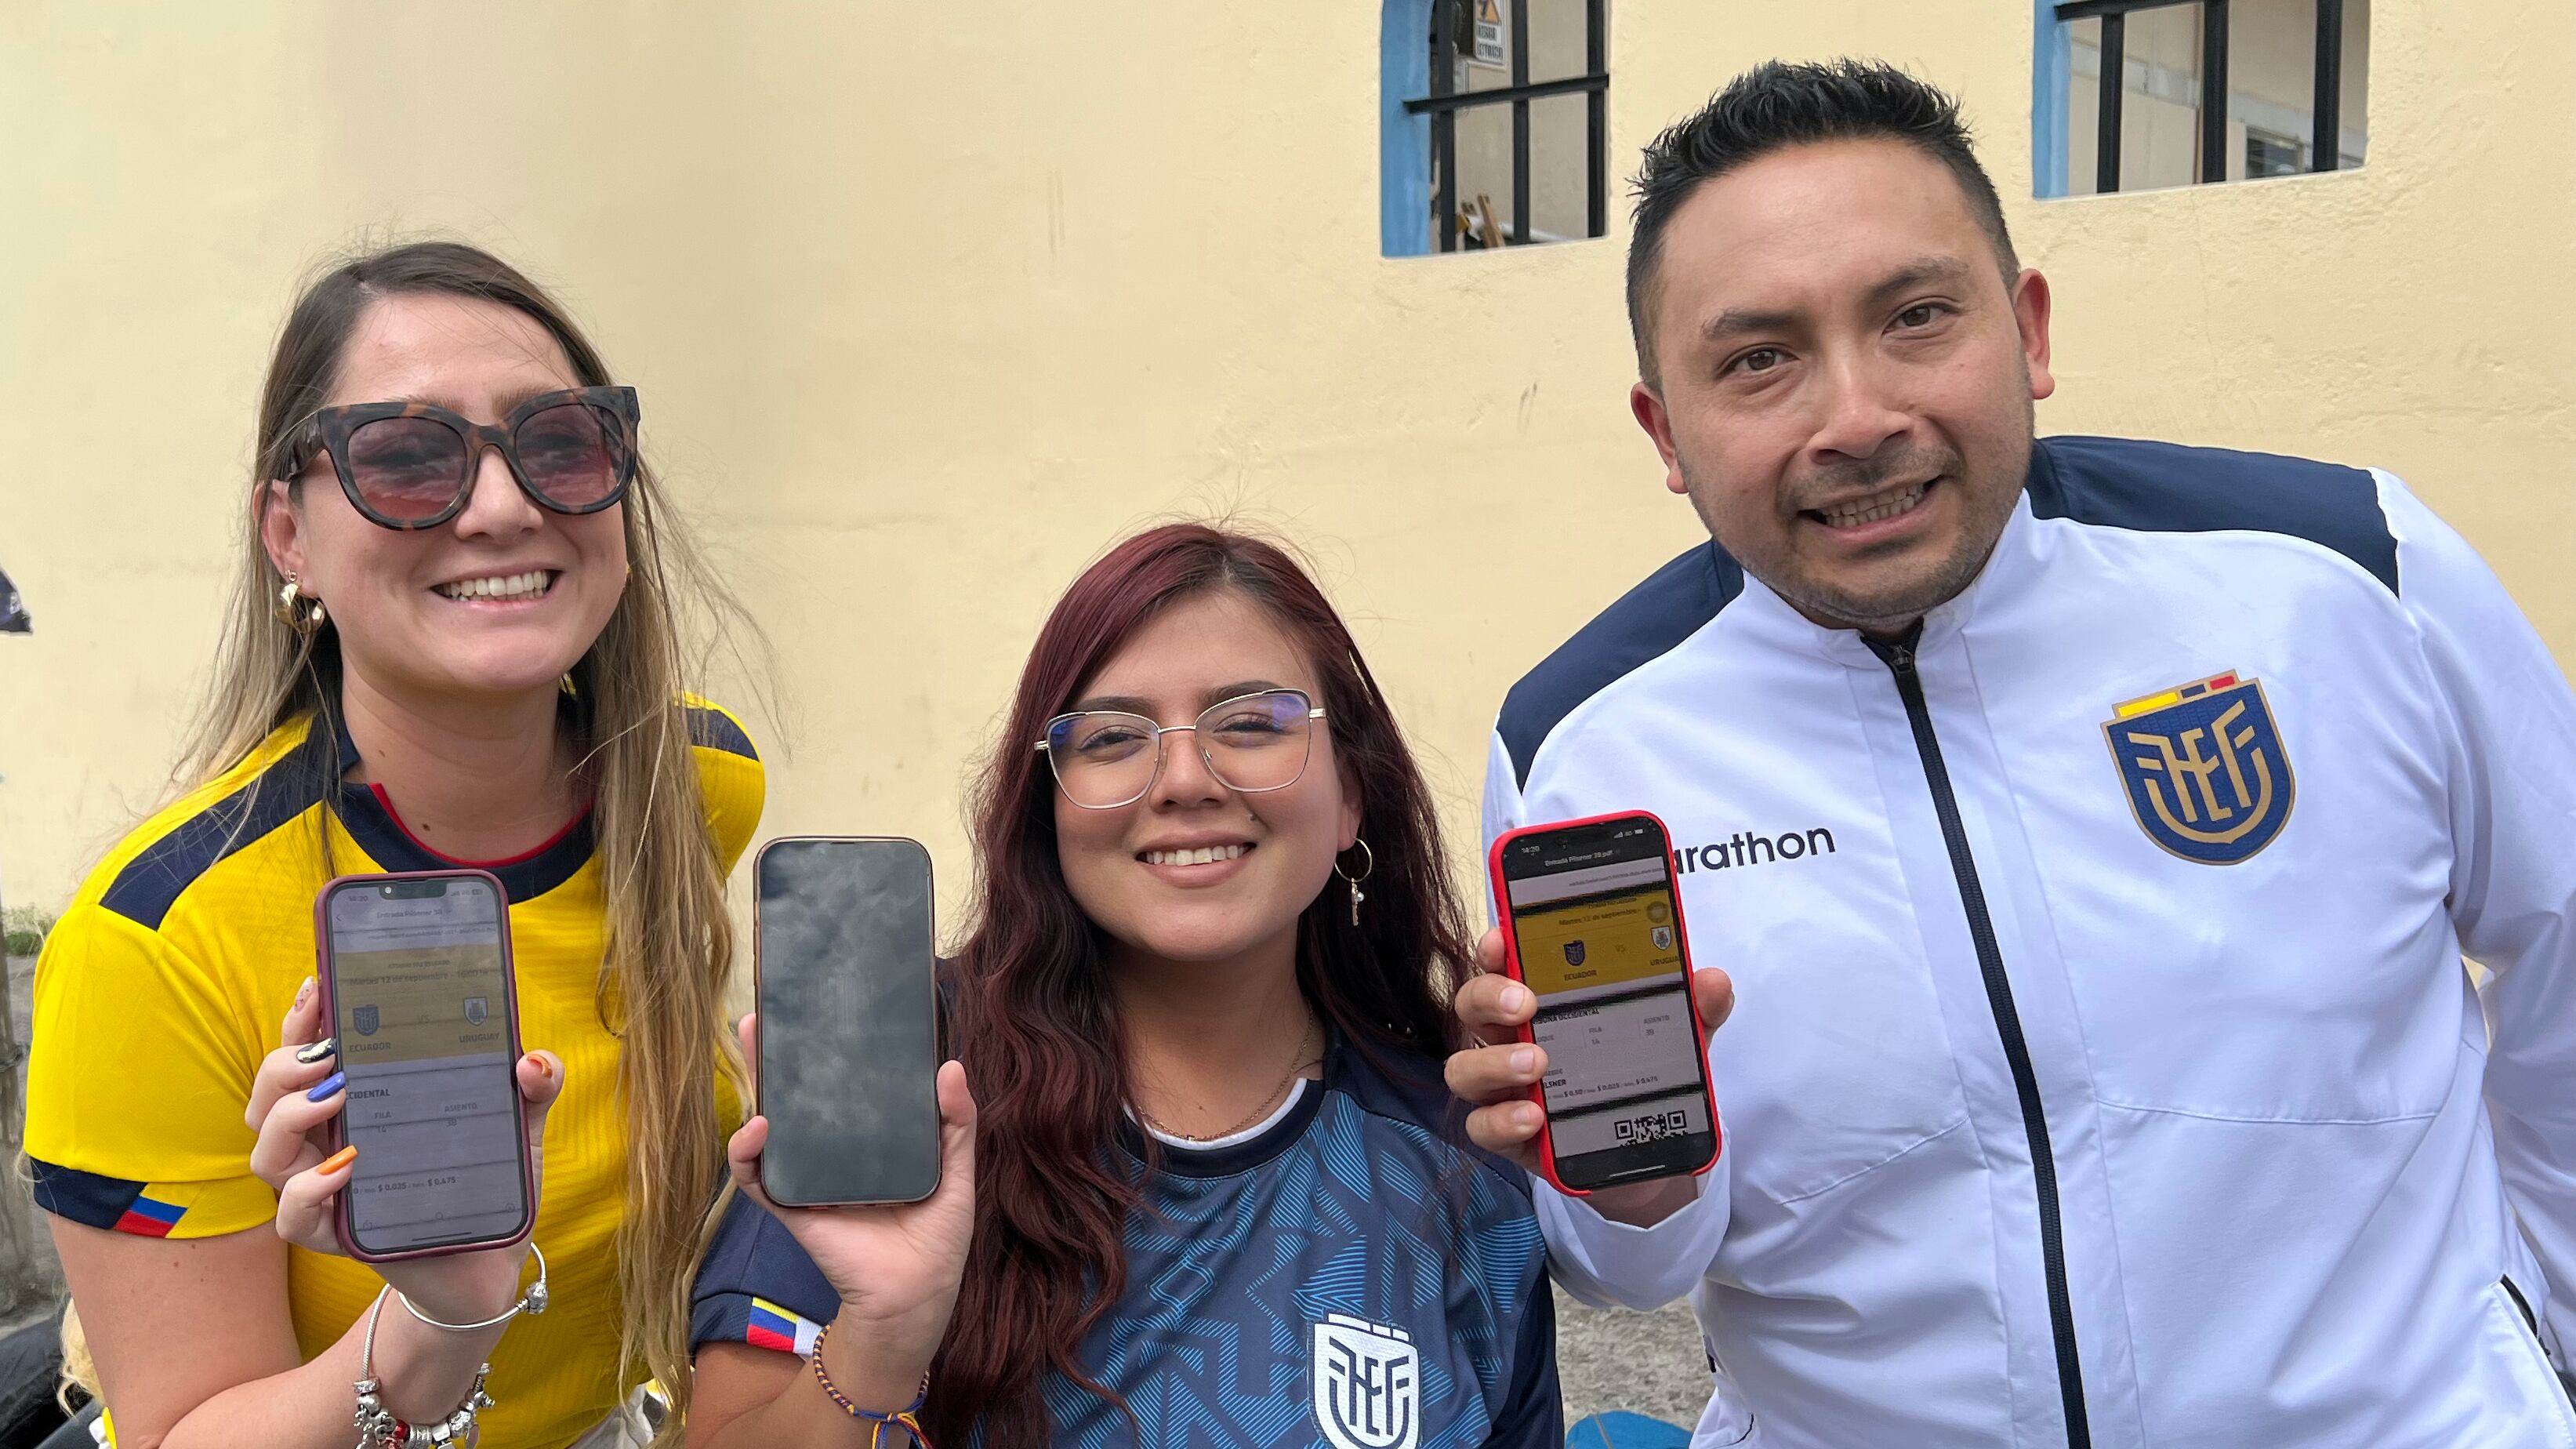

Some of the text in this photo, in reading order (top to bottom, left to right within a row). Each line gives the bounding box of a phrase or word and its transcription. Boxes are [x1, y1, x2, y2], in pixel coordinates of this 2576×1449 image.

[1564, 969, 1597, 981] ECUADOR
[350, 1032, 500, 1053] ECUADOR URUGUAY
[374, 1102, 477, 1120] FILA ASIENTO
